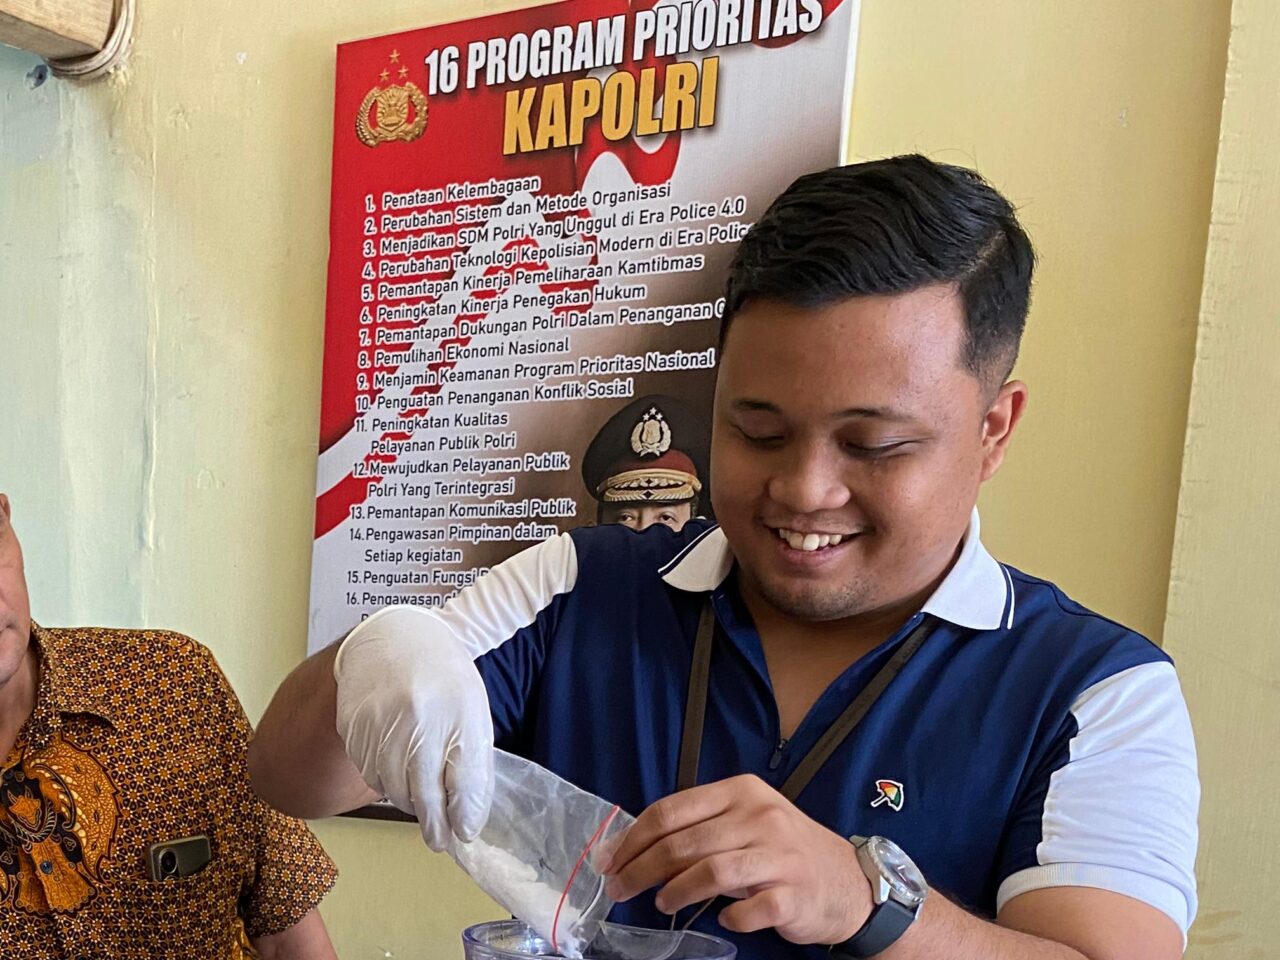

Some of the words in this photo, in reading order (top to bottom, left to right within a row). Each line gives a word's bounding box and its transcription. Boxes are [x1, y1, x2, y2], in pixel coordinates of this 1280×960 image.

[424, 45, 459, 96] 16
[466, 15, 626, 89] PROGRAM
[632, 0, 822, 61] PRIORITAS
[502, 56, 720, 156] KAPOLRI
[365, 219, 376, 233] 2.
[382, 211, 452, 231] Perubahan
[455, 204, 502, 222] Sistem
[506, 201, 532, 216] dan
[536, 194, 587, 213] Metode
[592, 182, 671, 208] Organisasi
[366, 197, 375, 210] 1.
[383, 189, 443, 208] Penataan
[447, 177, 540, 200] Kelembagaan
[364, 242, 375, 255] 3.
[381, 234, 454, 254] Menjadikan
[458, 227, 489, 245] SDM
[492, 223, 525, 240] Polri
[529, 221, 562, 237] Yang
[566, 213, 617, 235] Unggul
[621, 210, 635, 226] di
[639, 209, 665, 224] Era
[670, 202, 716, 221] Police
[721, 198, 745, 215] 4.0
[363, 264, 375, 278] 4.
[380, 256, 449, 276] Perubahan
[453, 248, 517, 267] Teknologi
[521, 241, 594, 264] Kepolisian
[599, 234, 654, 251] Modern
[659, 232, 672, 247] di
[677, 230, 703, 245] Era
[709, 224, 749, 242] Polic
[363, 287, 373, 300] 5.
[379, 278, 459, 298] Pemantapan
[463, 272, 511, 290] Kinerja
[515, 263, 613, 285] Pemeliharaan
[617, 255, 703, 275] Kamtibmas
[360, 309, 371, 322] 6.
[377, 302, 457, 322] Peningkatan
[461, 296, 508, 314] Kinerja
[513, 289, 589, 309] Penegakan
[594, 283, 646, 301] Hukum
[359, 331, 370, 345] 7.
[376, 325, 456, 344] Pemantapan
[460, 317, 527, 336] Dukungan
[532, 313, 565, 330] Polri
[570, 311, 614, 328] Dalam
[620, 303, 711, 324] Penanganan
[359, 354, 370, 367] 8.
[375, 348, 442, 366] Pemulihan
[447, 342, 504, 361] Ekonomi
[508, 337, 570, 356] Nasional
[357, 376, 368, 389] 9.
[374, 371, 435, 389] Menjamin
[440, 366, 510, 383] Keamanan
[514, 362, 575, 380] Program
[580, 356, 642, 374] Prioritas
[647, 350, 713, 370] Nasional
[356, 396, 372, 410] 10.
[377, 392, 443, 411] Penguatan
[448, 388, 530, 406] Penanganan
[534, 382, 583, 399] Konflik
[587, 380, 632, 396] Sosial
[356, 420, 368, 432] 11.
[372, 414, 450, 433] Peningkatan
[454, 412, 508, 427] Kualitas
[371, 437, 435, 456] Pelayanan
[439, 435, 480, 450] Publik
[484, 432, 516, 448] Polri
[353, 462, 368, 476] 12.
[369, 459, 449, 478] Mewujudkan
[453, 457, 521, 475] Pelayanan
[525, 453, 568, 470] Publik
[368, 483, 398, 498] Polri
[401, 483, 431, 499] Yang
[434, 478, 514, 498] Terintegrasi
[351, 506, 366, 520] 13.
[367, 503, 445, 521] Pemantapan
[449, 500, 528, 518] Komunikasi
[531, 499, 575, 516] Publik
[349, 527, 365, 541] 14.
[366, 527, 445, 544] Pengawasan
[449, 525, 511, 543] Pimpinan
[515, 523, 557, 539] dalam
[364, 550, 403, 565] Setiap
[407, 547, 462, 566] kegiatan
[347, 571, 362, 584] 15.
[363, 570, 429, 587] Penguatan
[433, 570, 477, 586] Fungsi
[346, 592, 361, 605] 16.
[362, 592, 441, 606] Pengawasan
